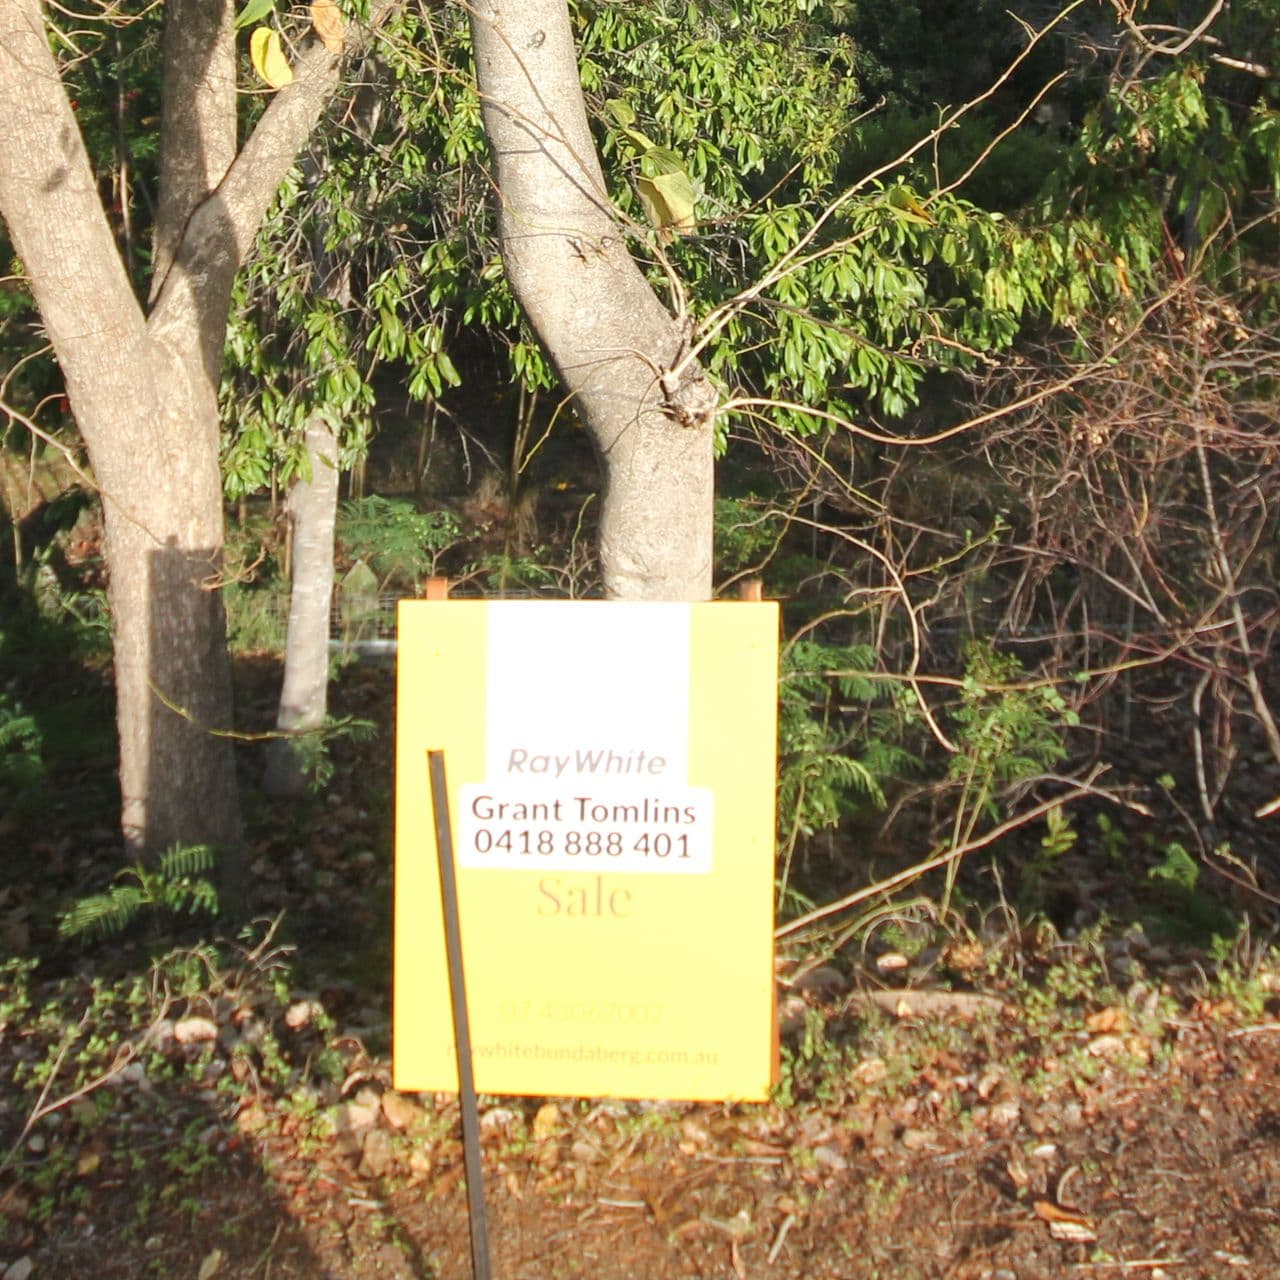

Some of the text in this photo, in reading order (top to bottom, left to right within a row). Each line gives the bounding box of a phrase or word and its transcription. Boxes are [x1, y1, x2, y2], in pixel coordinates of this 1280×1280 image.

[471, 794, 697, 826] Grant Tomlins
[473, 828, 693, 859] 0418 888 401
[536, 875, 634, 919] Sale
